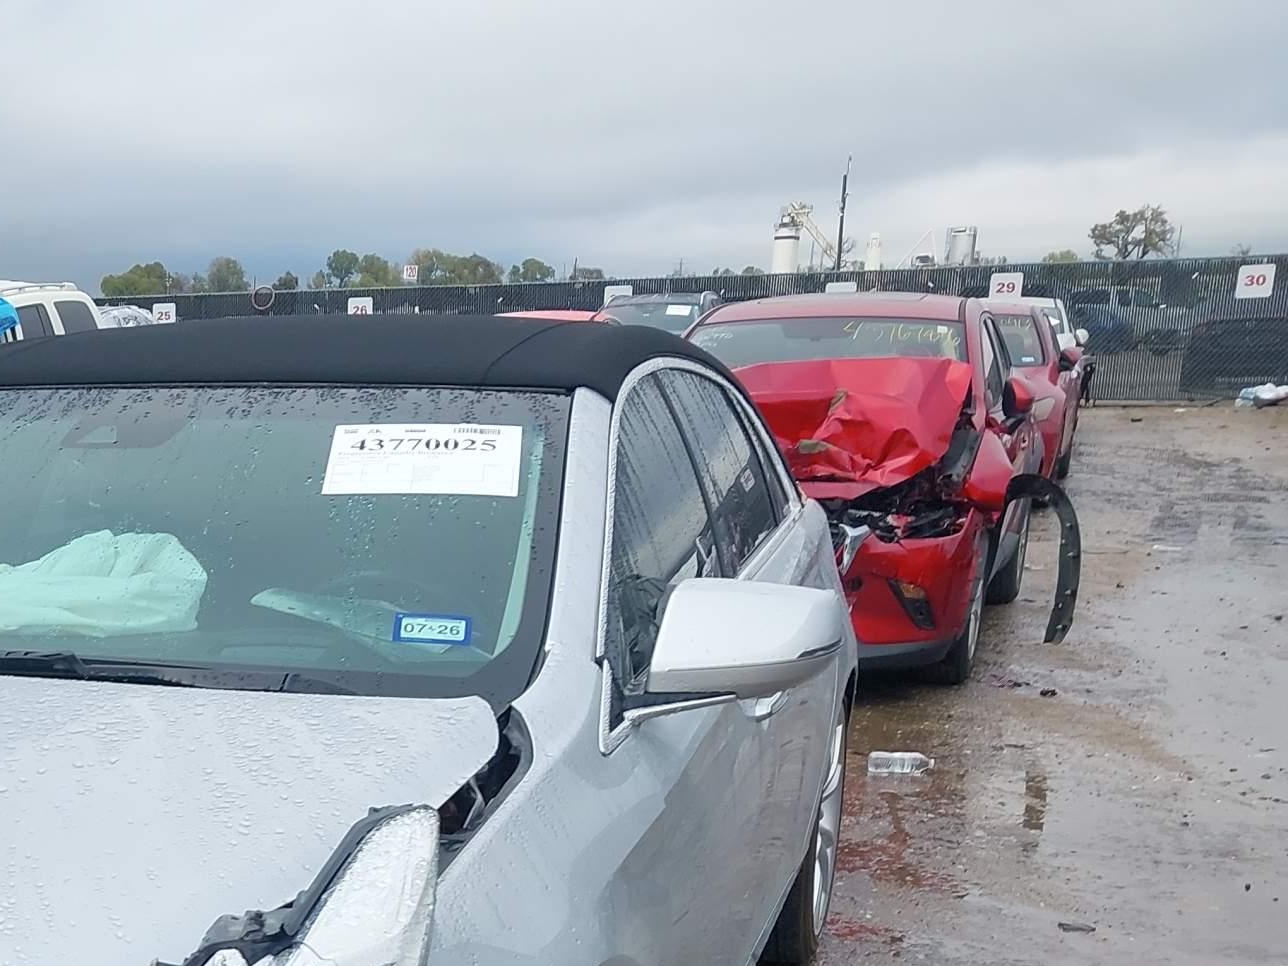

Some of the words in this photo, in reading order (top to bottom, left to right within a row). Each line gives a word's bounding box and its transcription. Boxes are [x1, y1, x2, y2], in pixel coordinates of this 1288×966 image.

[1244, 274, 1267, 287] 30
[995, 281, 1016, 294] 29
[157, 311, 171, 321] 25
[352, 305, 368, 315] 26
[350, 437, 497, 452] 43770025
